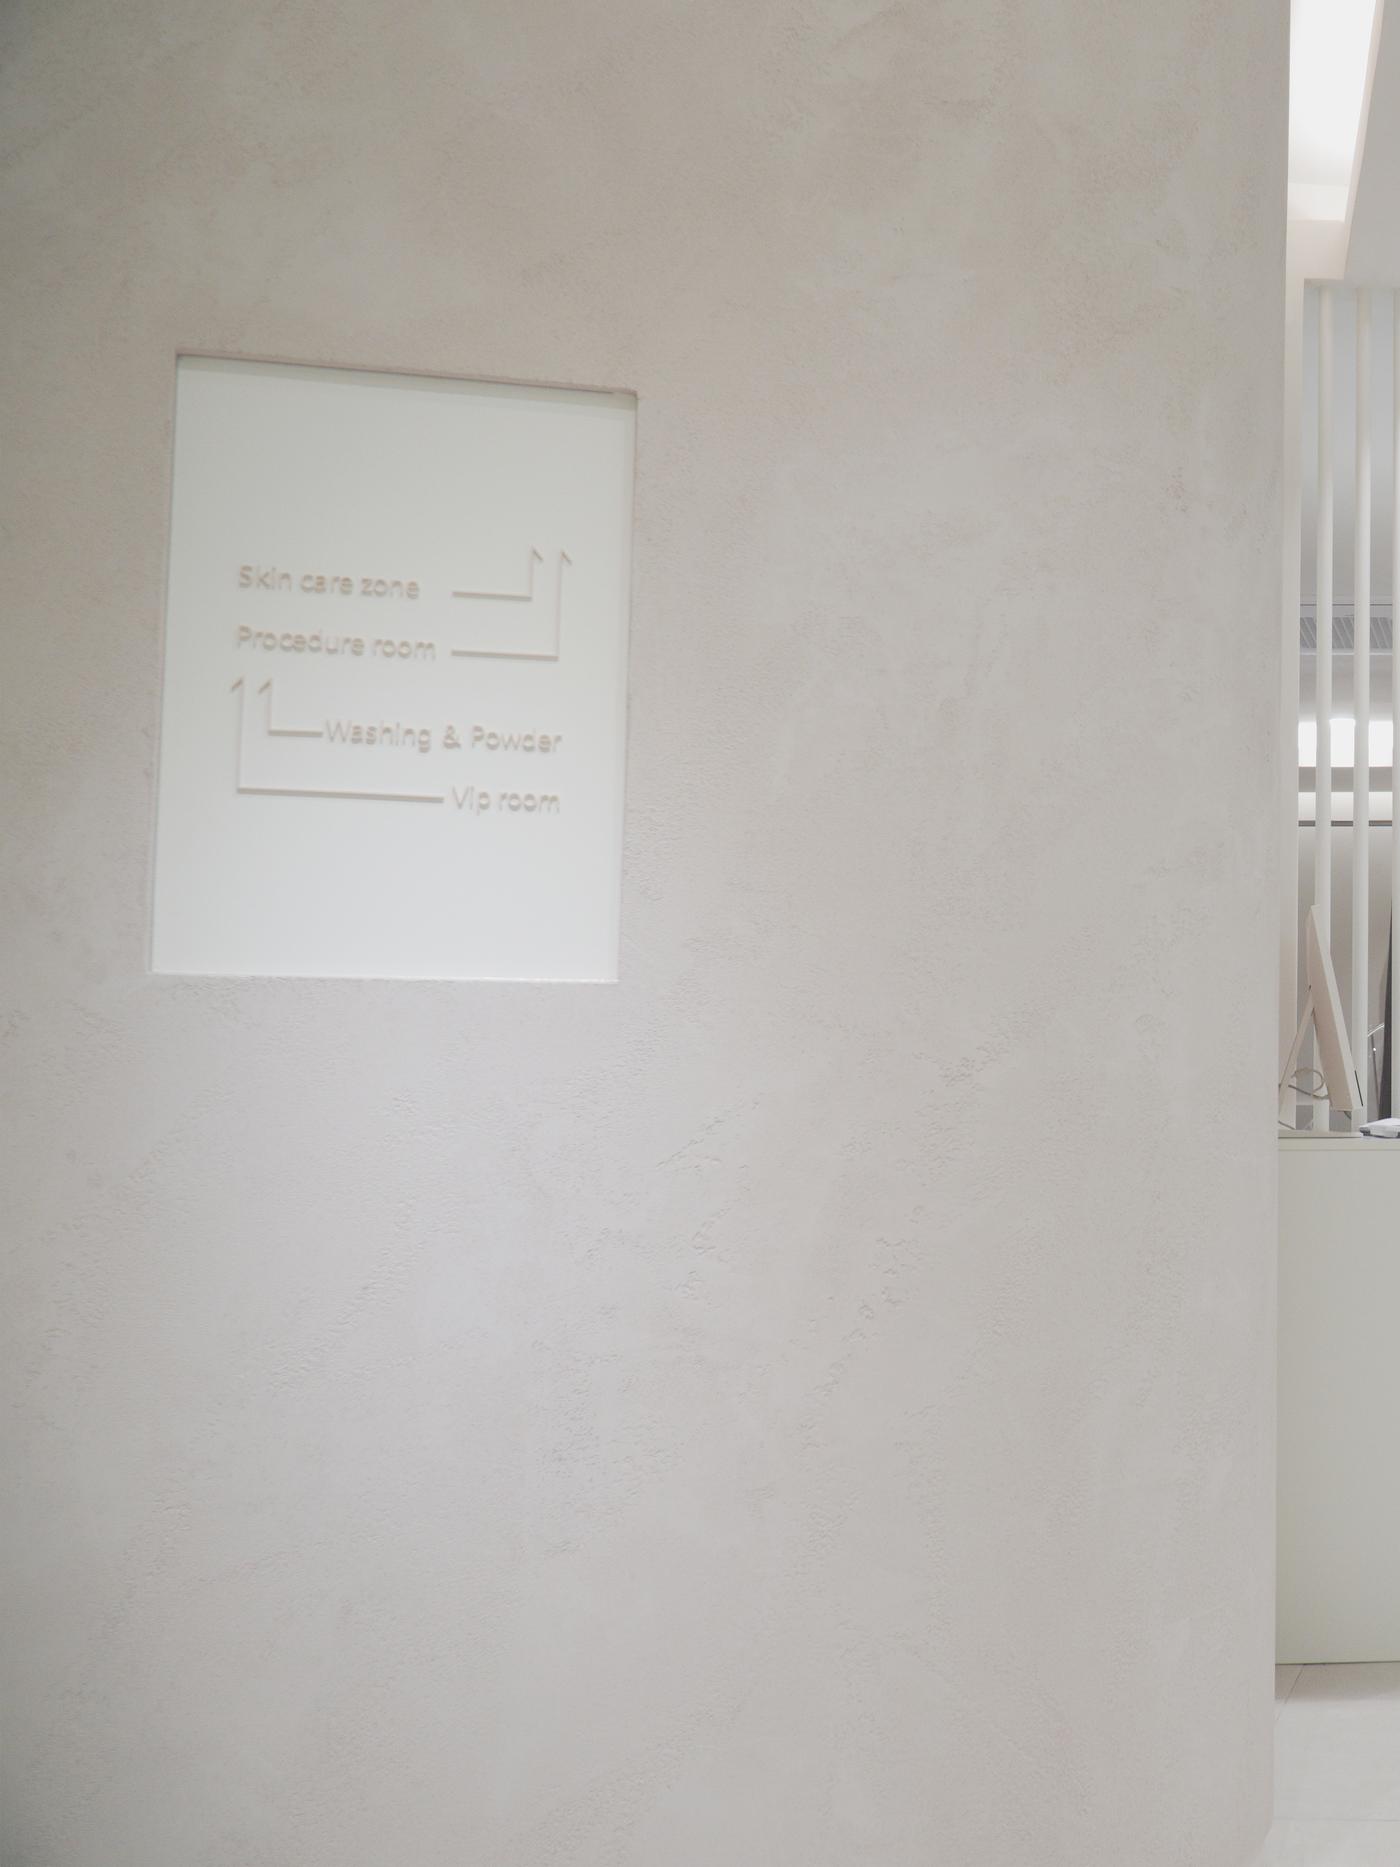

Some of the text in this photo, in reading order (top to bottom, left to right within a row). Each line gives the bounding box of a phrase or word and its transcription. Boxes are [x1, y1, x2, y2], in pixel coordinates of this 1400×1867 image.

[238, 564, 420, 599] Skin care zone
[236, 624, 437, 661] Procedure room
[325, 719, 563, 754] Washing & Powder
[450, 785, 560, 815] Vip room
